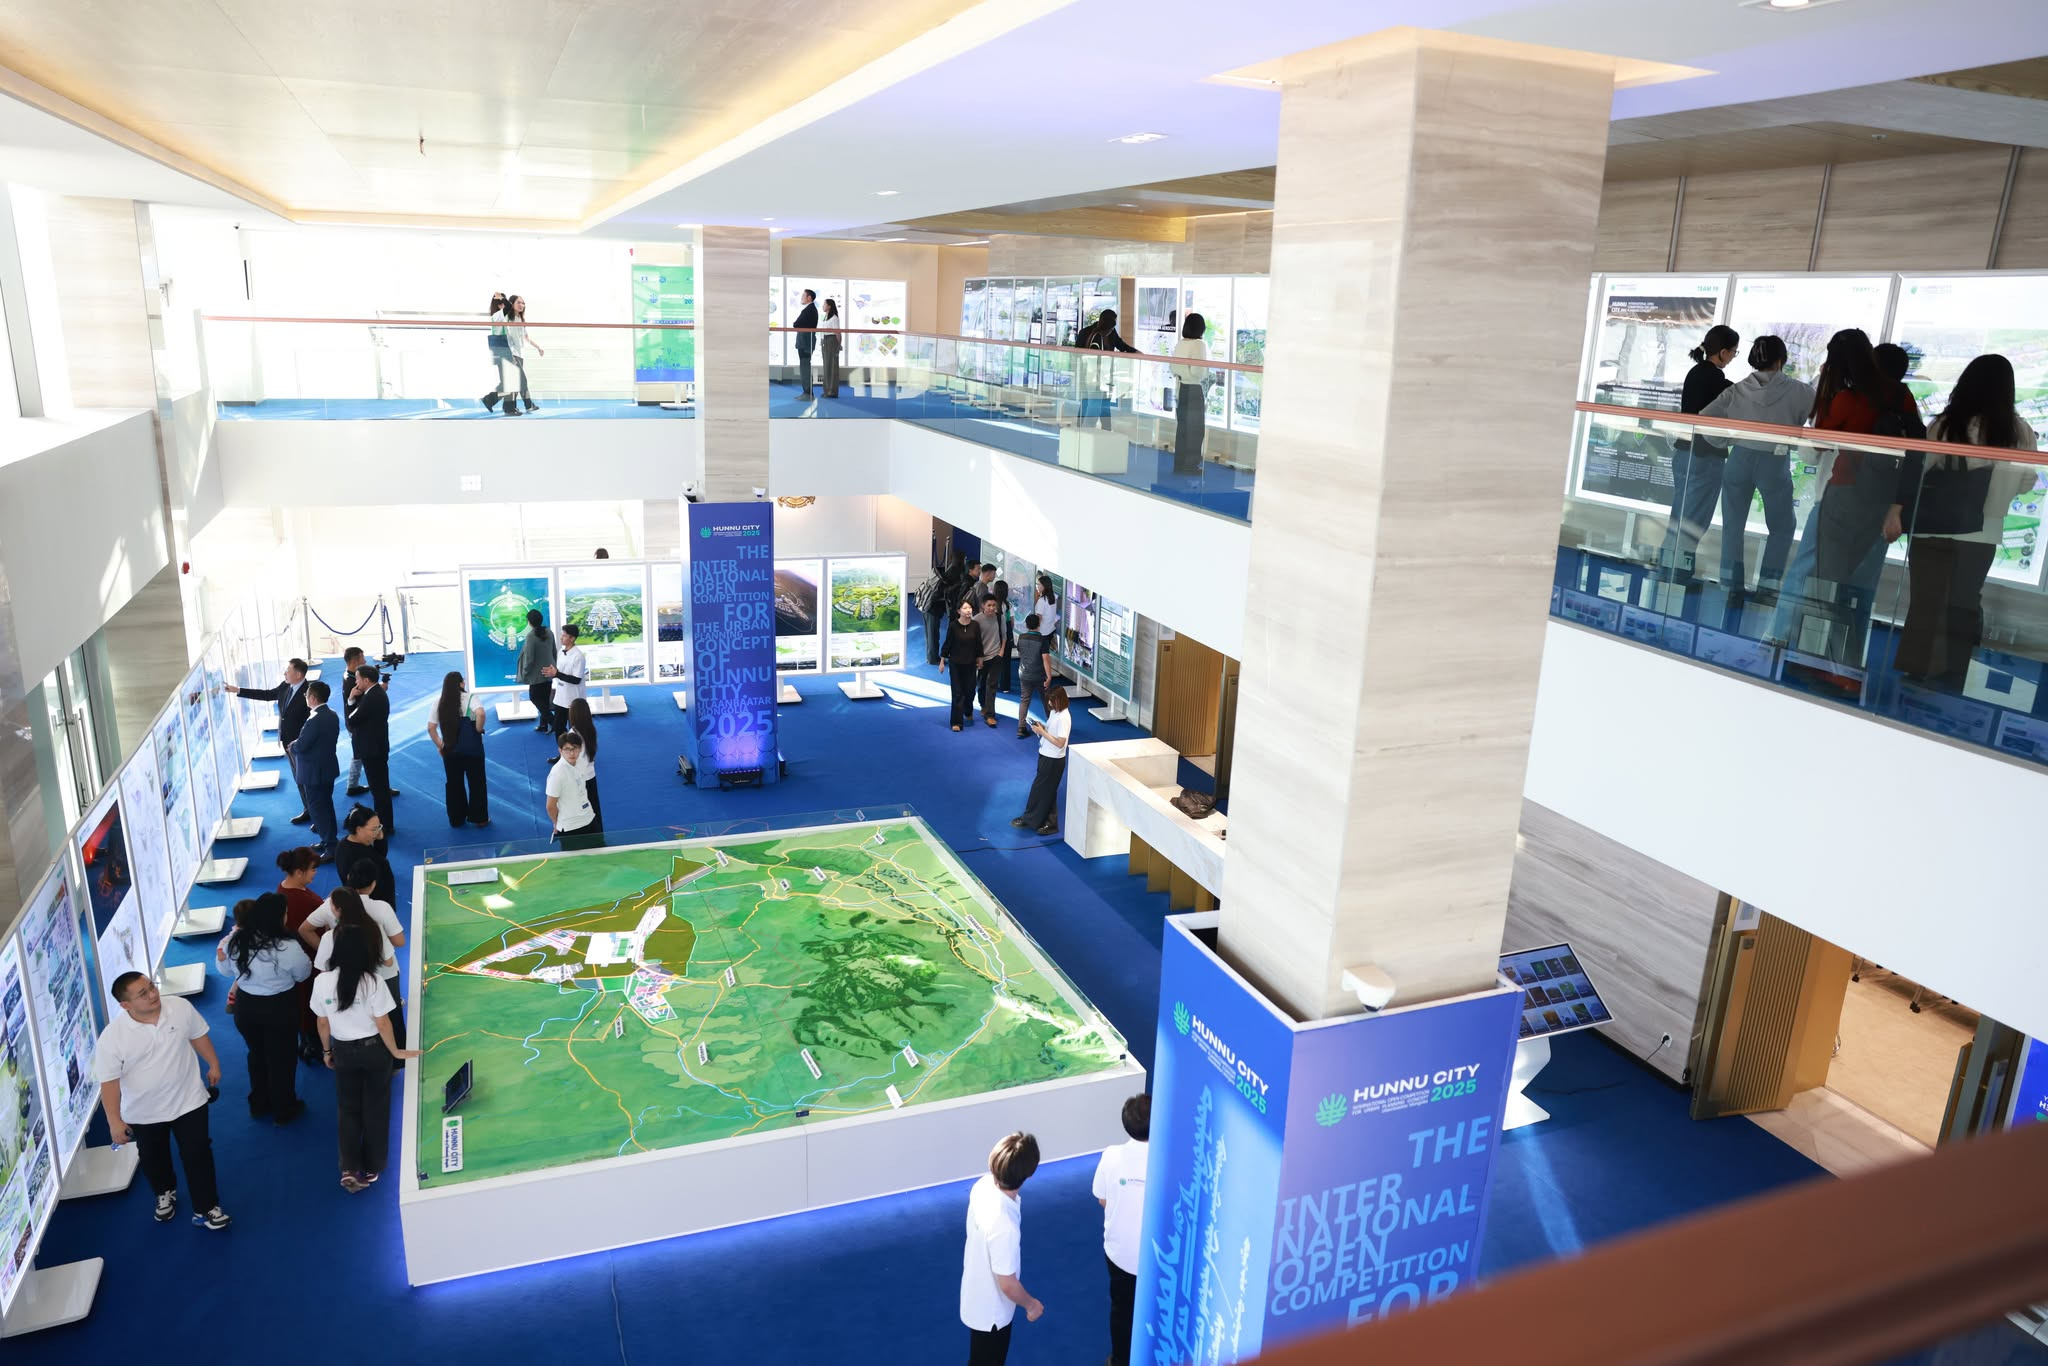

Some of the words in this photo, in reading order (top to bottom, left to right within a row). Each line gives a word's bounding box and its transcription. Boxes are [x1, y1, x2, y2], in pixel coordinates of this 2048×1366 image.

[736, 545, 769, 559] THE
[692, 560, 738, 574] INTER
[692, 569, 769, 584] NATIONAL
[693, 581, 736, 595] OPEN
[694, 592, 770, 604] COMPETITION
[724, 602, 769, 621] FOR
[695, 622, 720, 633] THE
[724, 619, 770, 631] URBAN
[695, 631, 743, 640] PLANNING
[695, 636, 770, 653] CONCEPT
[698, 651, 730, 672] OF
[696, 666, 771, 686] HUNNU
[697, 696, 771, 708] ULAANBAATAR
[698, 705, 749, 716] MONGOLIA
[700, 710, 773, 739] 2025
[1192, 1015, 1236, 1065] HUNNU
[1237, 1060, 1269, 1096] CITY
[1353, 1074, 1429, 1103] HUNNU
[1433, 1063, 1480, 1085] CITY
[1430, 1078, 1477, 1102] 2025
[1236, 1075, 1267, 1115] 2025
[1408, 1115, 1491, 1168] THE
[1280, 1173, 1402, 1232] INTER
[1275, 1183, 1475, 1264] NATIONAL
[1274, 1232, 1389, 1294] OPEN
[1271, 1240, 1469, 1316] COMPETITION
